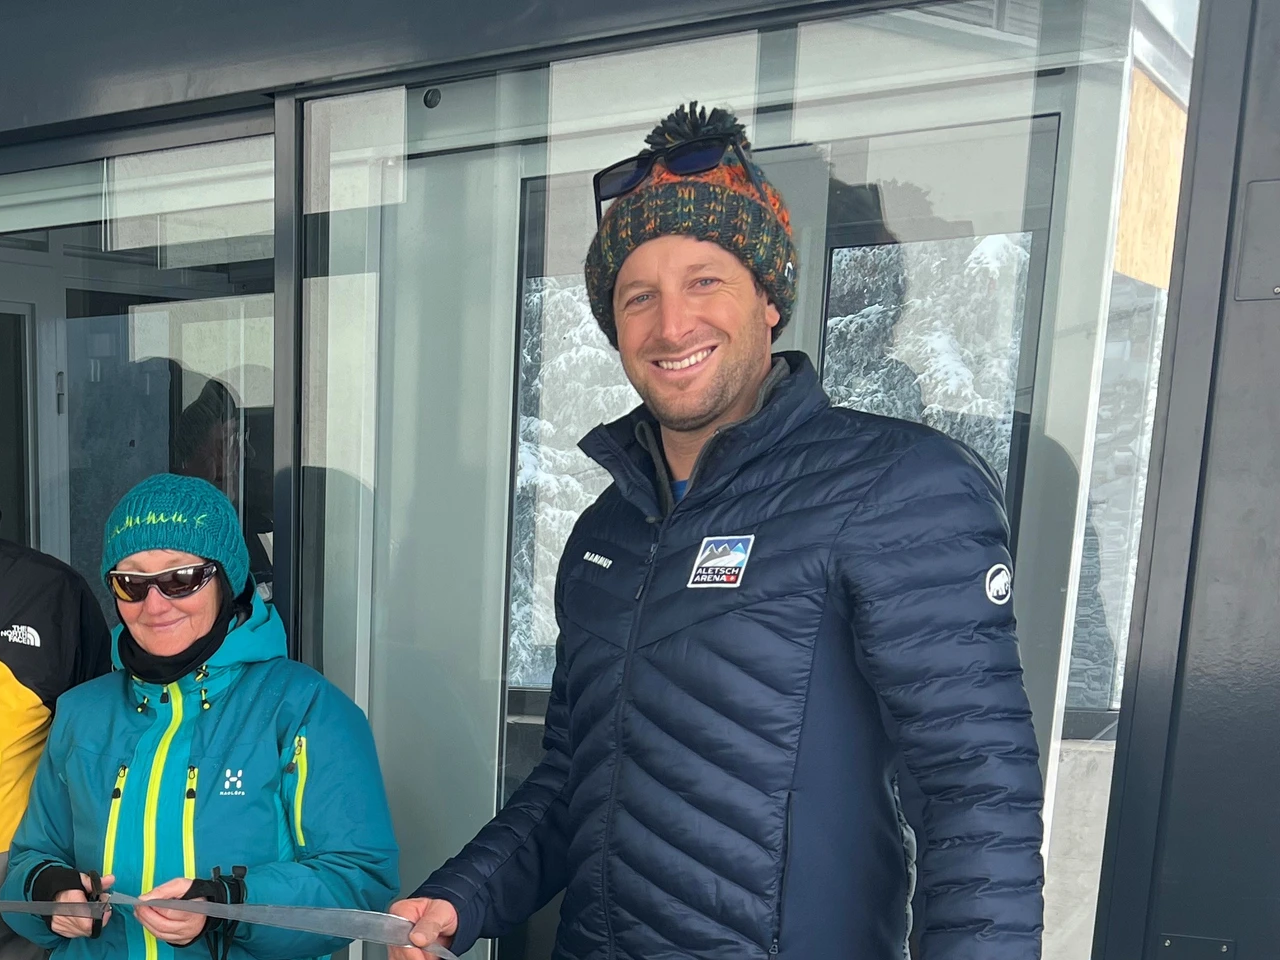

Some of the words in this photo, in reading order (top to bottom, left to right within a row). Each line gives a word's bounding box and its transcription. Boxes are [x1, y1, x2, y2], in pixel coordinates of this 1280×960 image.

[696, 567, 740, 575] ALETSCH
[693, 574, 727, 582] ARENA
[11, 624, 27, 632] THE
[0, 629, 27, 638] NORTH
[8, 636, 27, 645] FACE
